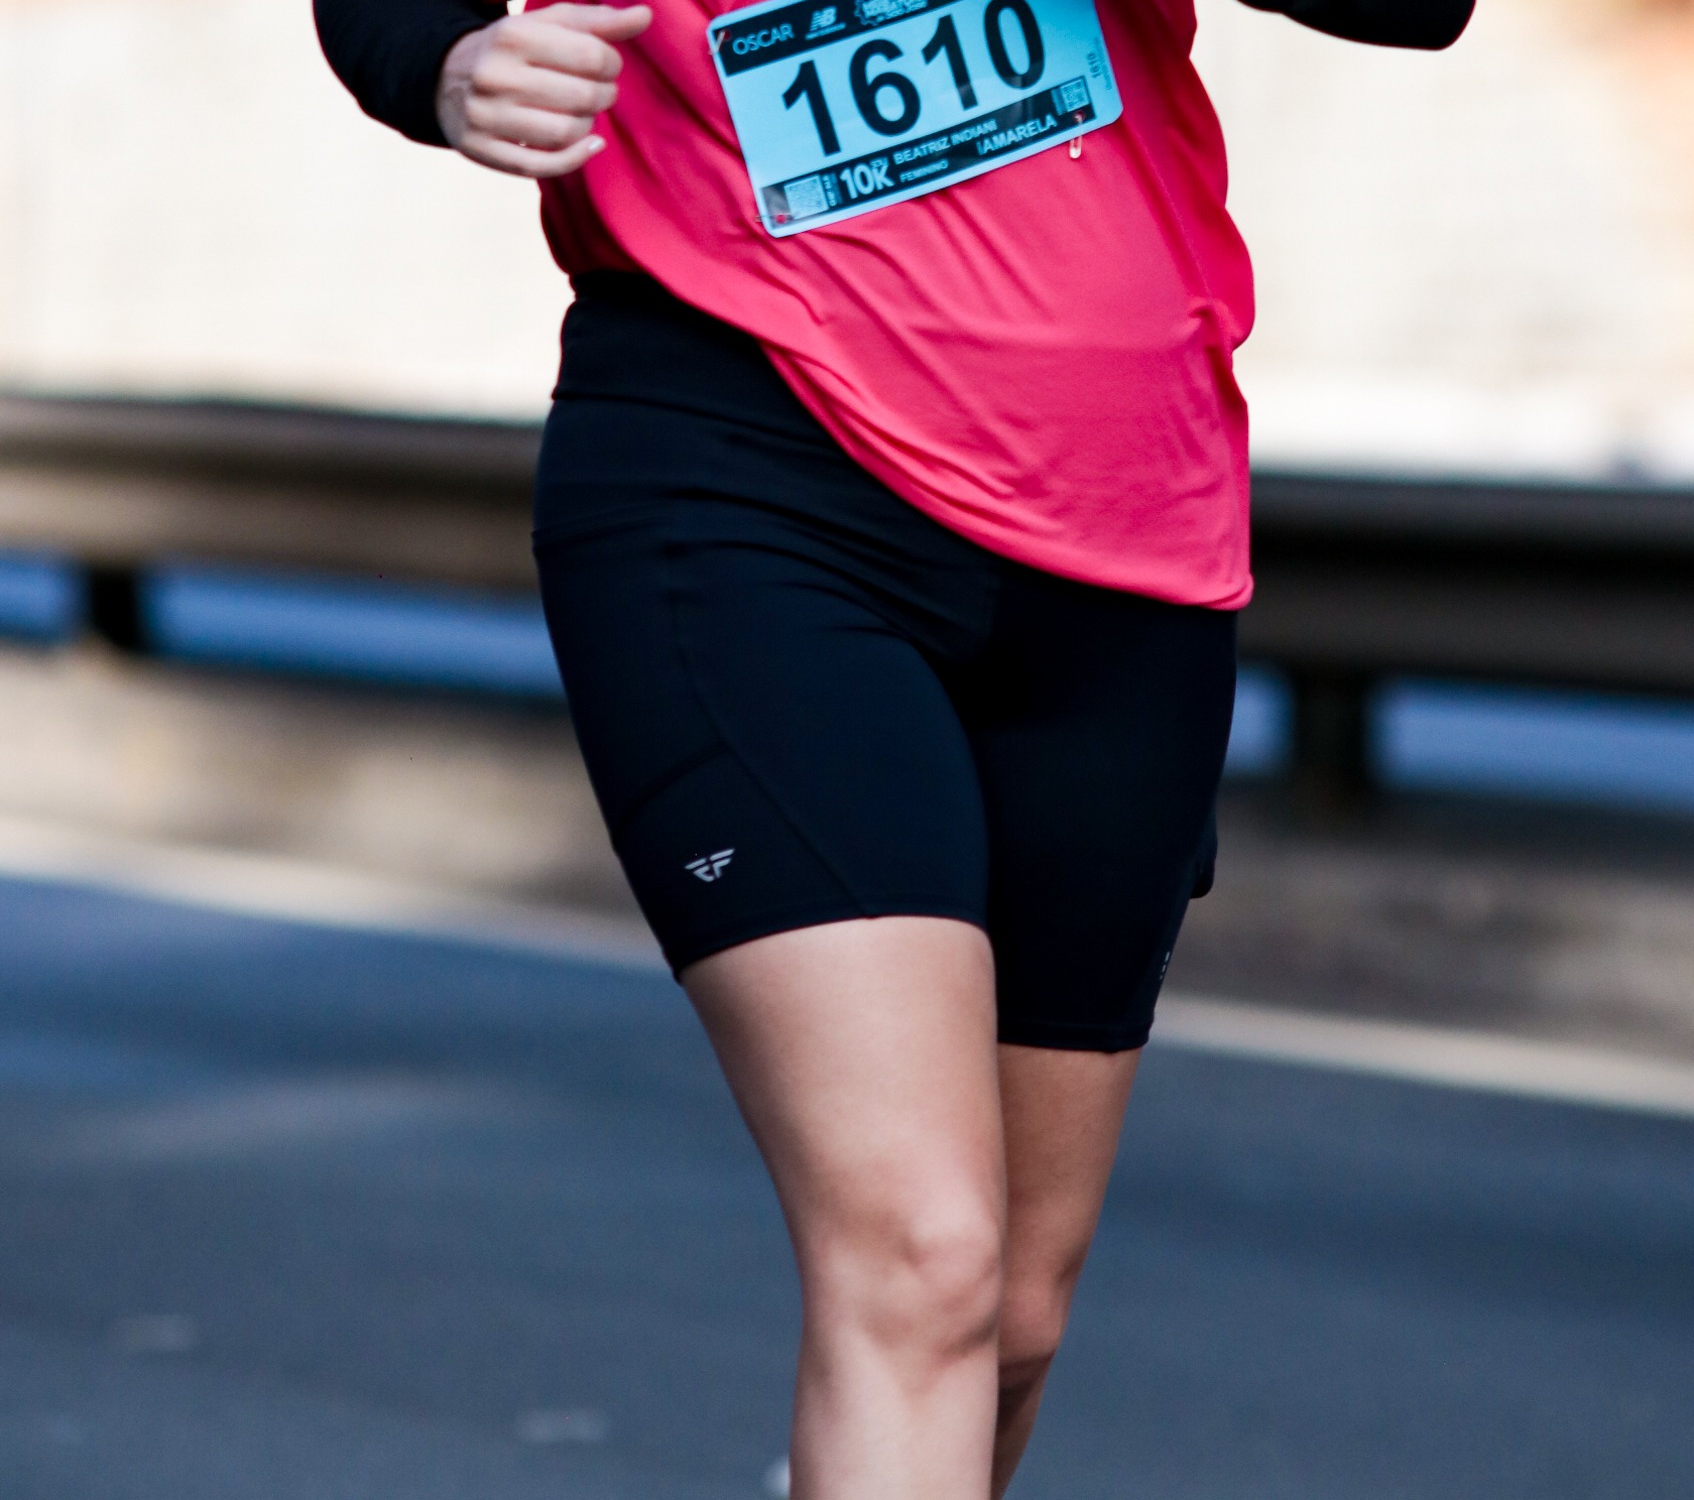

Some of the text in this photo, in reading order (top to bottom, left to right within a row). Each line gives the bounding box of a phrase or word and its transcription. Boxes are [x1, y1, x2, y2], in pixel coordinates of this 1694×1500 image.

[732, 22, 795, 55] OSCAR
[892, 135, 951, 166] BEATRIZ
[950, 118, 998, 146] INDIANI
[839, 162, 895, 199] 10K
[899, 158, 949, 183] FEMININO
